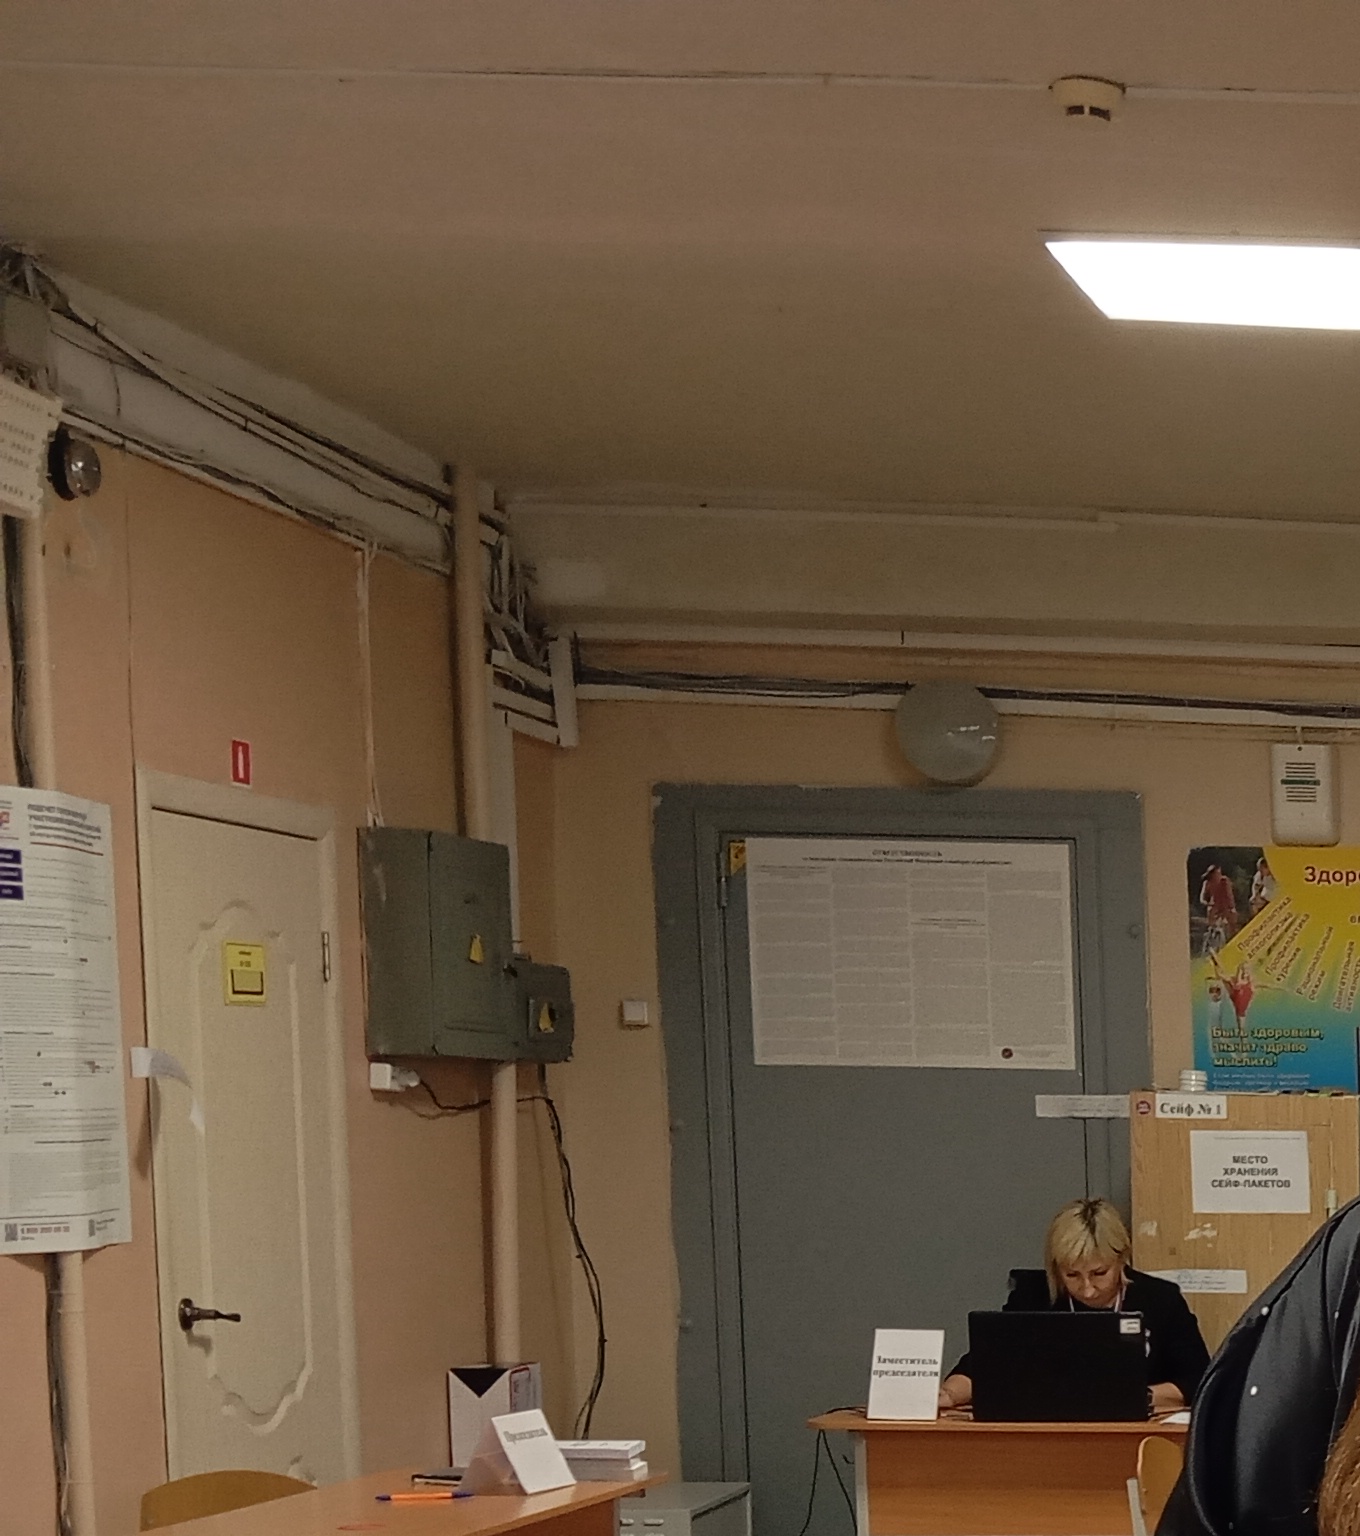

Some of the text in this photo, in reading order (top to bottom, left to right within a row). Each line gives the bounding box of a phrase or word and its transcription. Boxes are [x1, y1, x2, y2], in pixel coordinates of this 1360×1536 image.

[1237, 896, 1292, 951] Профилактика
[1265, 913, 1310, 976] Профилактика
[1296, 926, 1334, 996] Рациональный
[1333, 941, 1355, 1010] Двигательная
[1211, 1026, 1324, 1041] Быть здоровым,
[1212, 1042, 1309, 1055] значит здраво
[1213, 1056, 1278, 1068] мыслить!
[1160, 1103, 1222, 1117] Сейф № 1
[1232, 1155, 1268, 1164] МЕСТО
[1222, 1167, 1279, 1176] ХРАНЕНИЯ
[1211, 1179, 1291, 1188] СЕЙФ-ПАКЕТОВ
